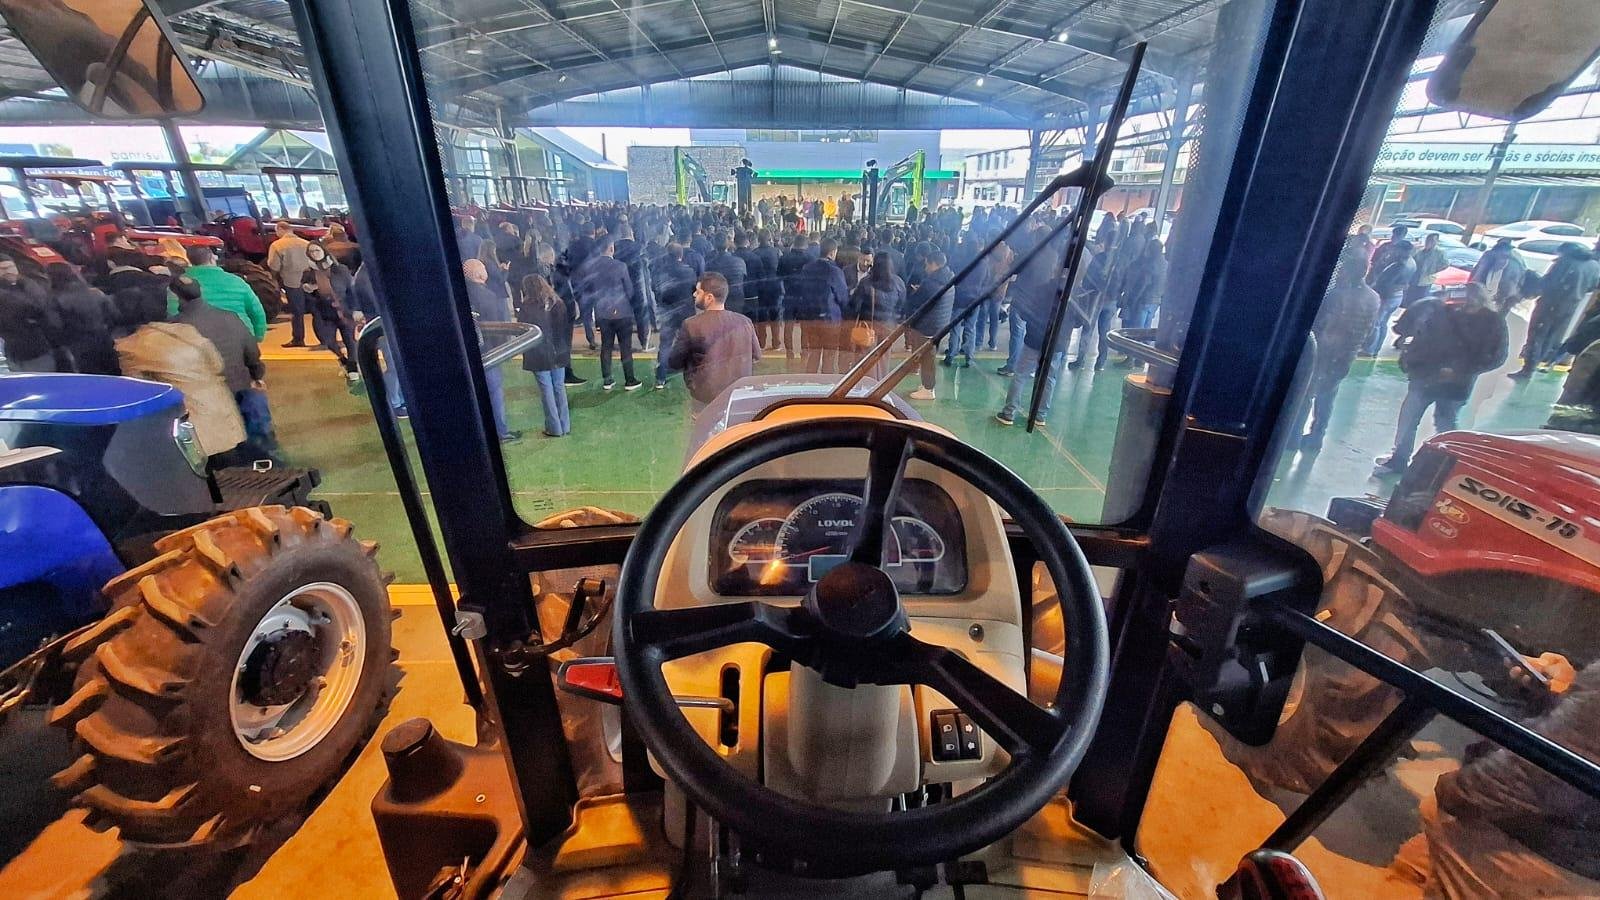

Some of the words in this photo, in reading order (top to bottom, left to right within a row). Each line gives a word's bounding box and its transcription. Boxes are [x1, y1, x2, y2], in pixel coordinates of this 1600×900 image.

[1418, 149, 1459, 161] devem
[1462, 152, 1484, 162] ser
[1523, 153, 1532, 162] e
[1534, 151, 1575, 162] sócias
